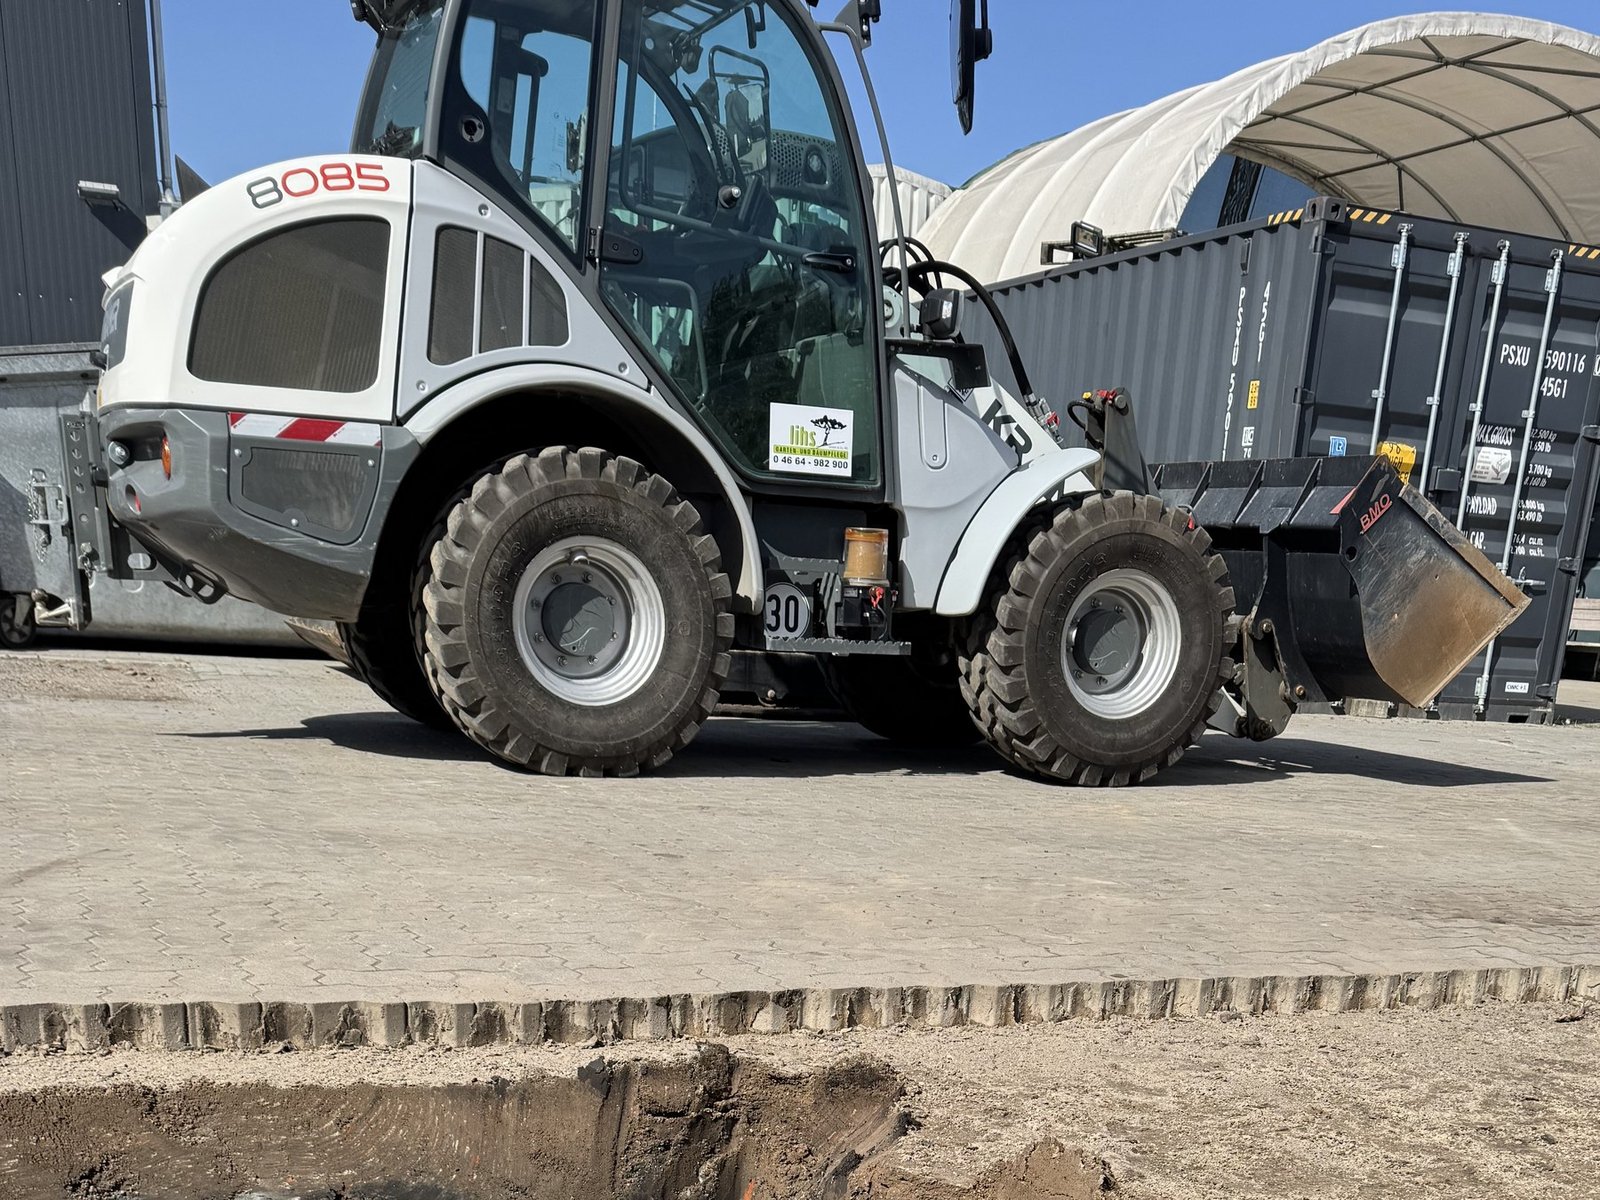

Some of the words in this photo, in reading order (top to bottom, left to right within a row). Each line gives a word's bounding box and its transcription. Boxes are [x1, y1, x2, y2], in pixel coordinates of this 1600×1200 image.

[246, 162, 391, 209] 8085
[1232, 286, 1246, 367] PSXU
[1257, 281, 1271, 362] 45G1
[1500, 343, 1531, 367] PSXU
[1544, 349, 1587, 374] 590116
[1540, 376, 1568, 399] 45G1
[789, 425, 816, 447] lihs
[1544, 441, 1552, 453] lb
[1548, 430, 1557, 443] kg
[773, 455, 779, 463] 0
[781, 456, 793, 465] 46
[795, 457, 806, 466] 64
[813, 458, 830, 469] 982
[832, 461, 848, 470] 900
[1528, 463, 1545, 475] 3.700
[1544, 465, 1553, 479] kg
[1466, 495, 1498, 516] PAYLOAD
[1536, 500, 1545, 513] kg
[1535, 512, 1543, 523] lb
[766, 594, 799, 633] 30
